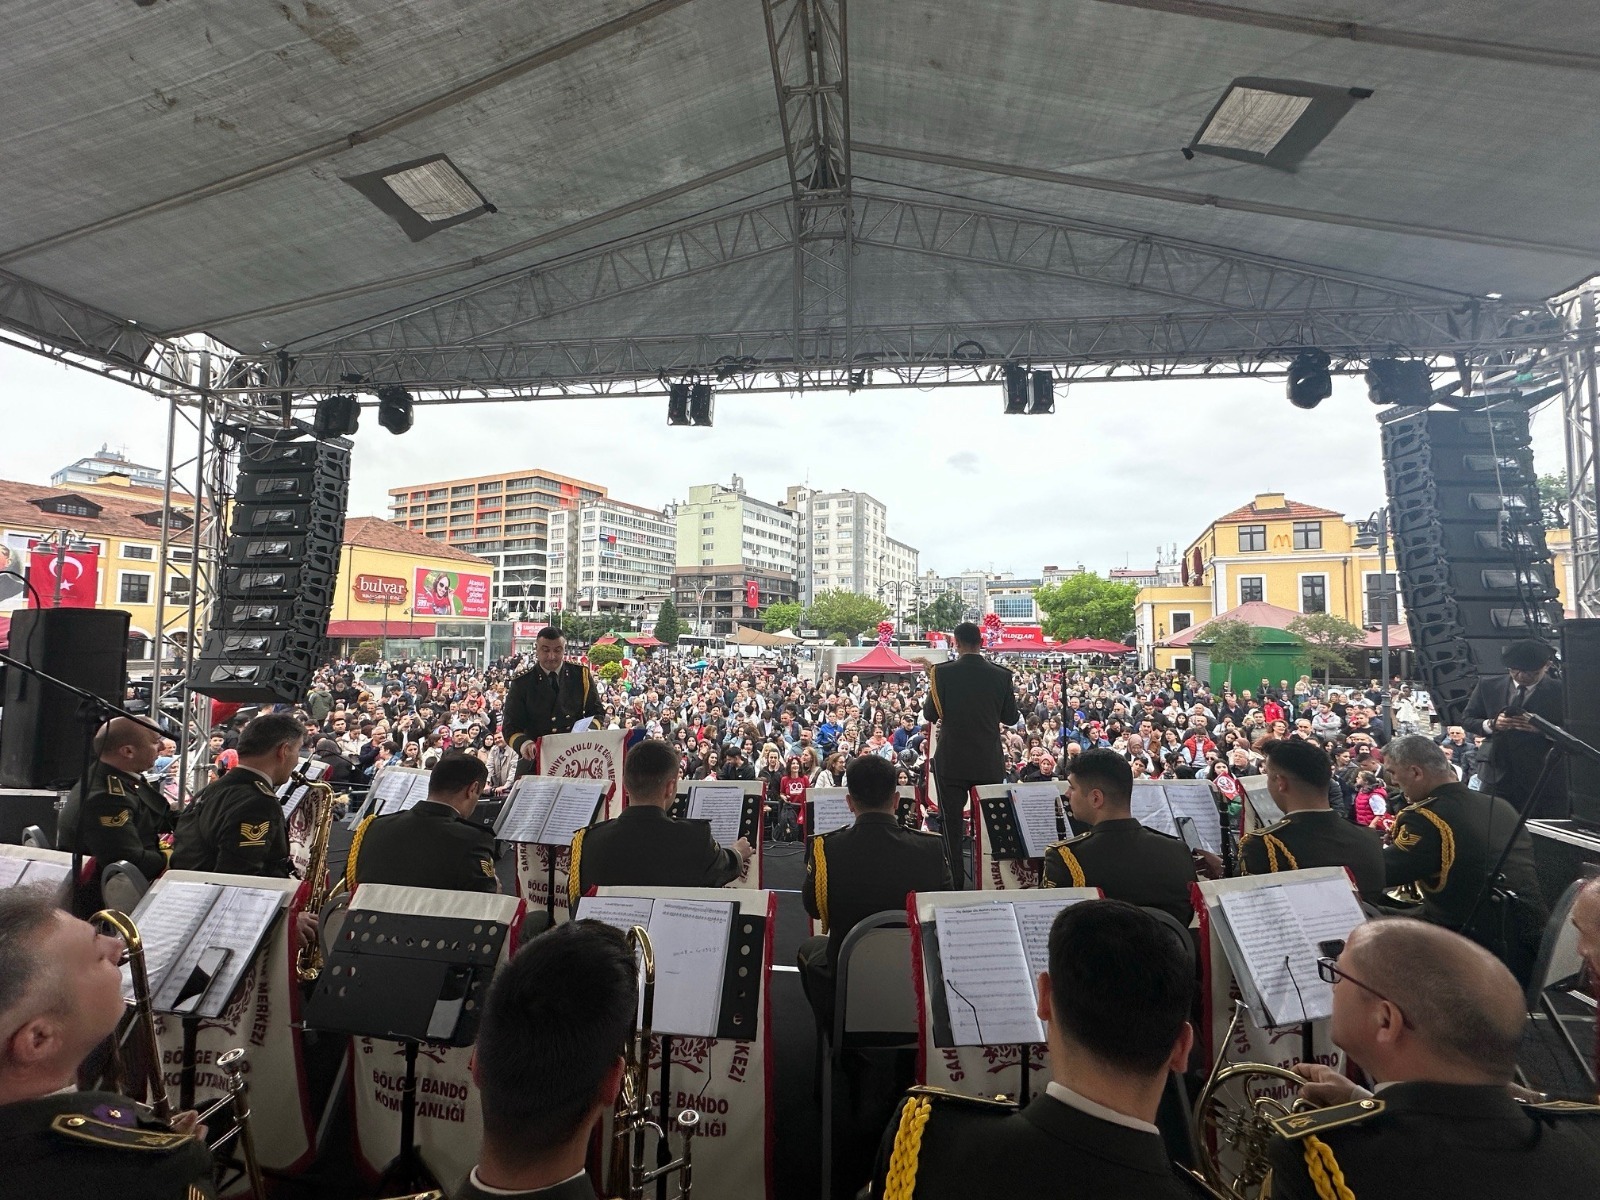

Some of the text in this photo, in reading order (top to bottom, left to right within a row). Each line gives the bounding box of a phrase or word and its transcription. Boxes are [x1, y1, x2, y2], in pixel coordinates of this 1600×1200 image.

[360, 576, 404, 594] bulvar
[565, 742, 592, 756] OKULU
[594, 743, 604, 752] VE
[607, 768, 616, 780] ME
[520, 843, 529, 872] SAHRA
[528, 880, 548, 892] BÖLG
[529, 893, 568, 909] KOMUANL
[163, 1046, 212, 1065] BÖGE
[728, 1040, 750, 1083] KEZİ
[942, 1049, 965, 1082] SAH
[373, 1070, 468, 1101] BÖLG BANDO
[375, 1089, 465, 1122] KOMANLIĞI
[677, 1092, 729, 1114] BANDO
